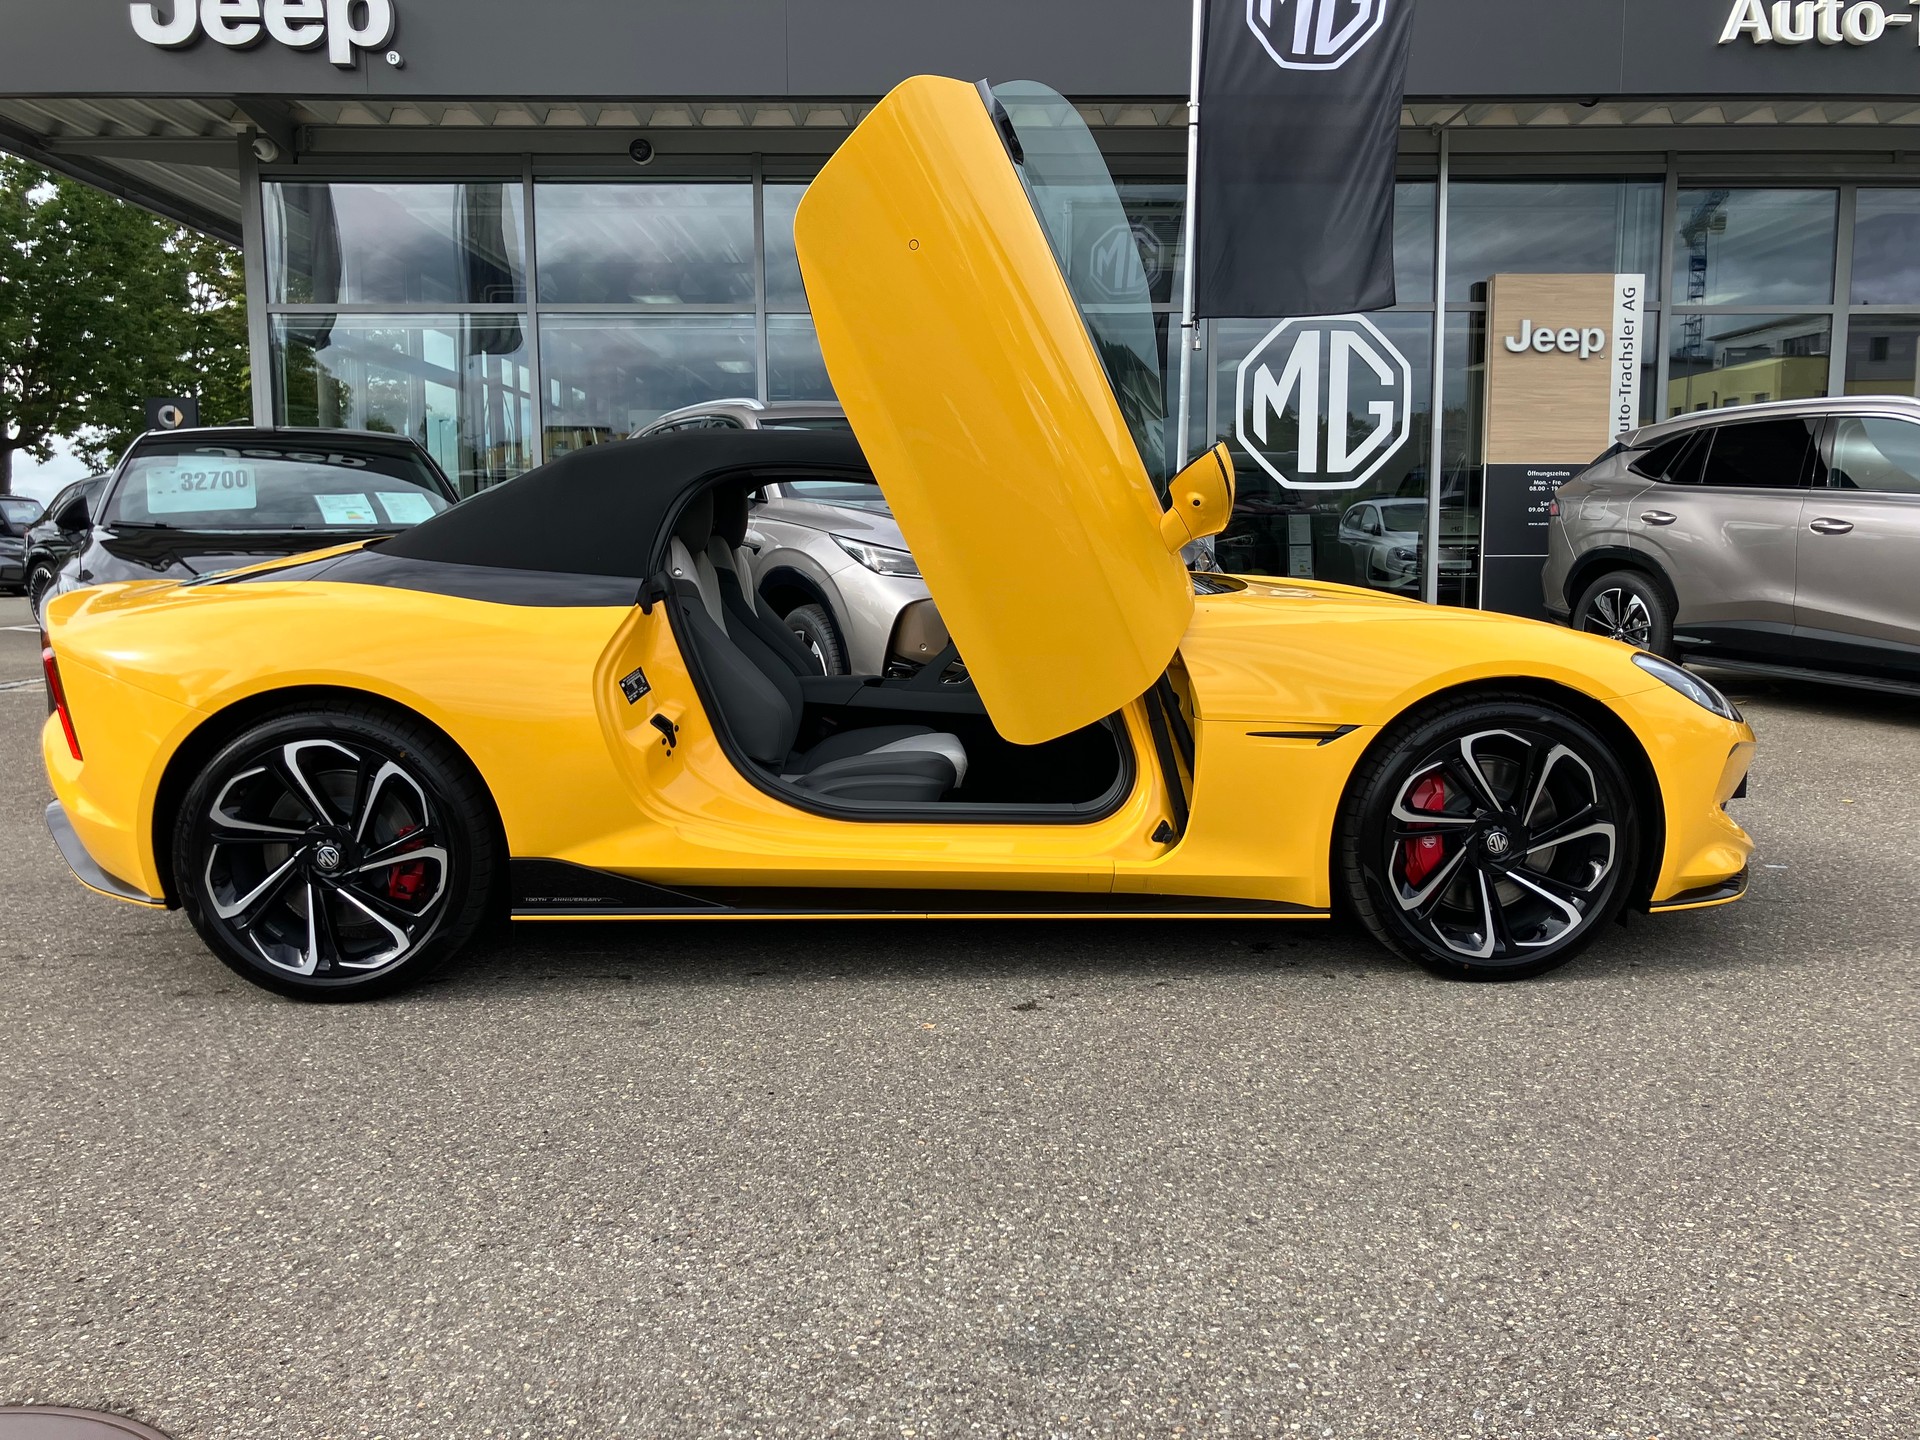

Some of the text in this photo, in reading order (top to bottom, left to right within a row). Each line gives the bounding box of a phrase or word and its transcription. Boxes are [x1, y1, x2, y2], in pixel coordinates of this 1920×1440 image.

[1504, 319, 1605, 359] Jeep
[1618, 287, 1636, 433] uto-Trachsler AG
[1252, 330, 1395, 473] MG
[180, 470, 248, 491] 32700
[1527, 470, 1570, 478] Öffnungszeiten
[319, 850, 337, 867] MG
